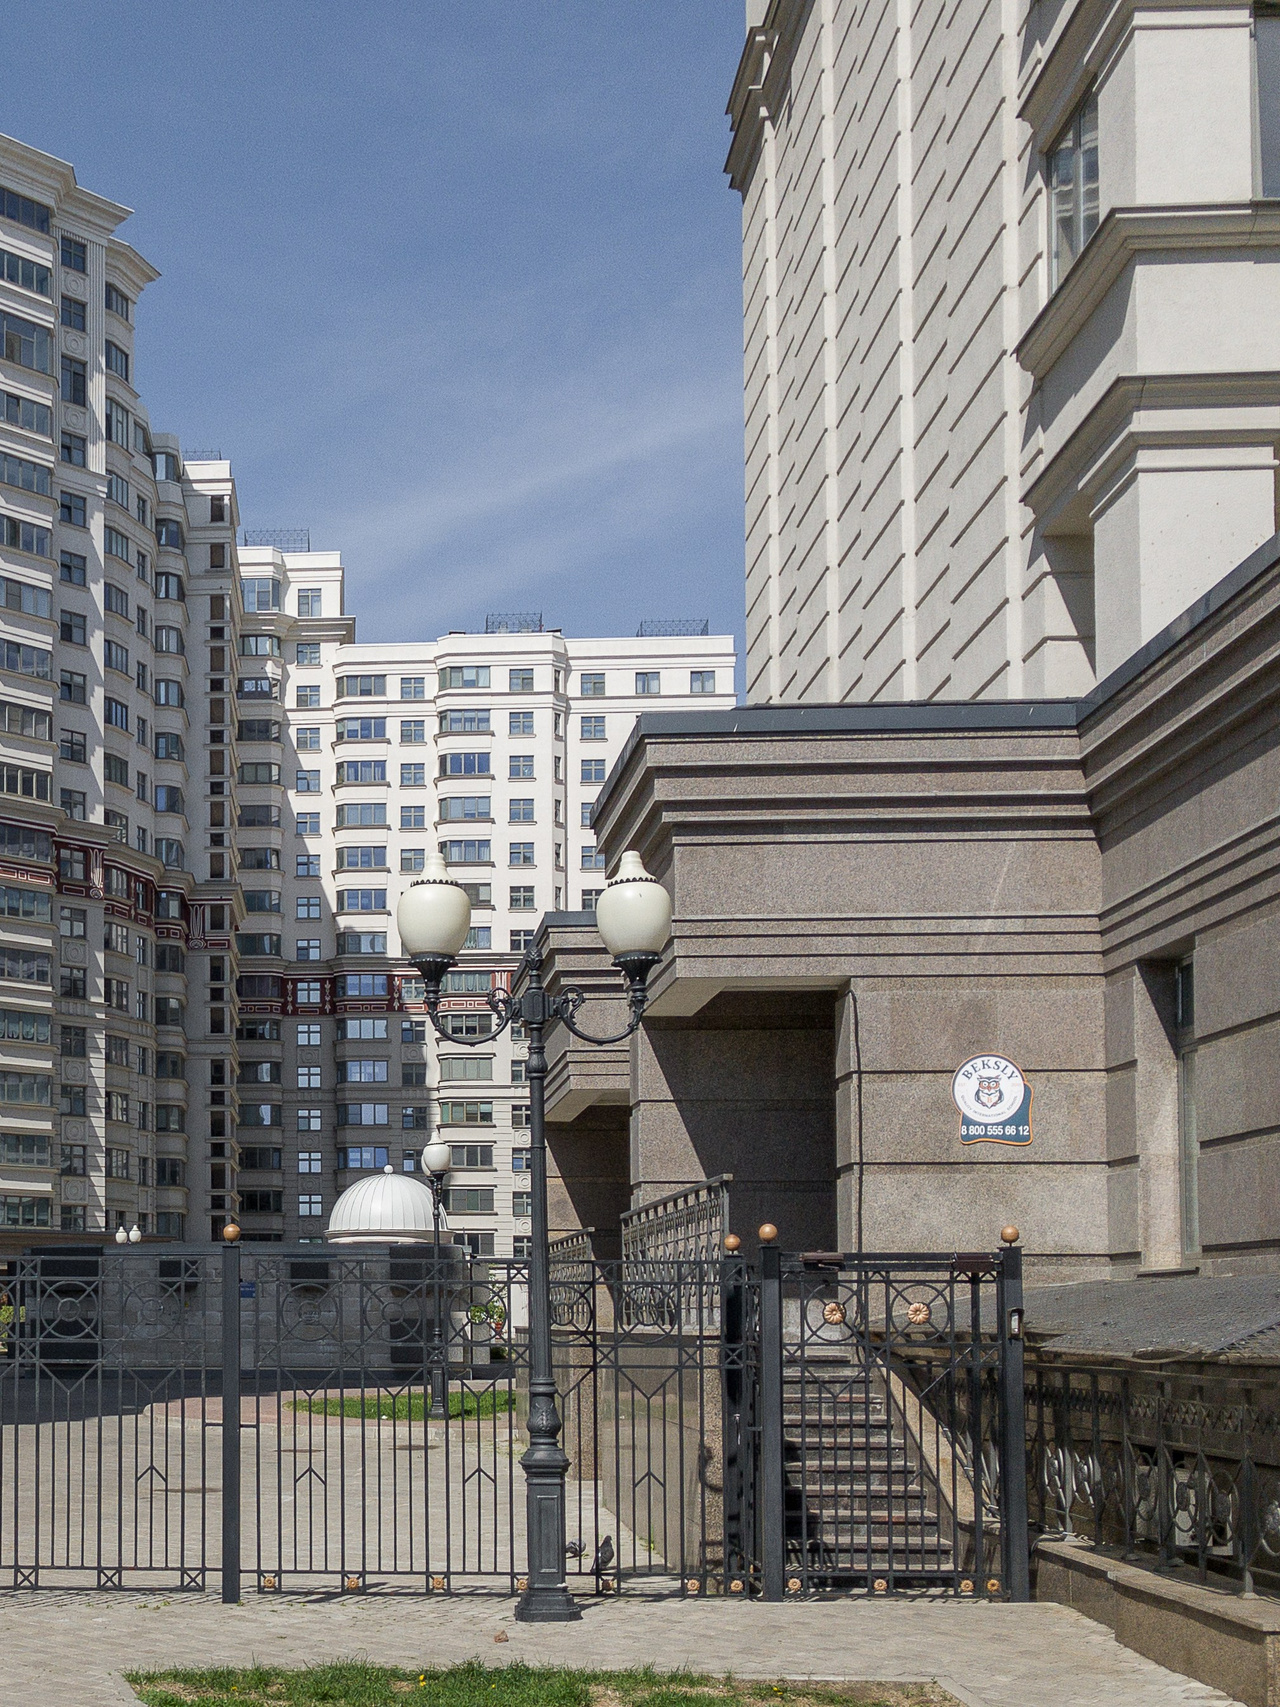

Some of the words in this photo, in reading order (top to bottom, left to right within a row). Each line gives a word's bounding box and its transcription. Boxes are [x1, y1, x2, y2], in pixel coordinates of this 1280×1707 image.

[962, 1059, 1018, 1080] BEKSLY
[961, 1125, 967, 1135] 8
[969, 1125, 985, 1135] 800
[987, 1125, 1003, 1135] 555
[1005, 1125, 1016, 1135] 66
[1019, 1125, 1029, 1135] 12
